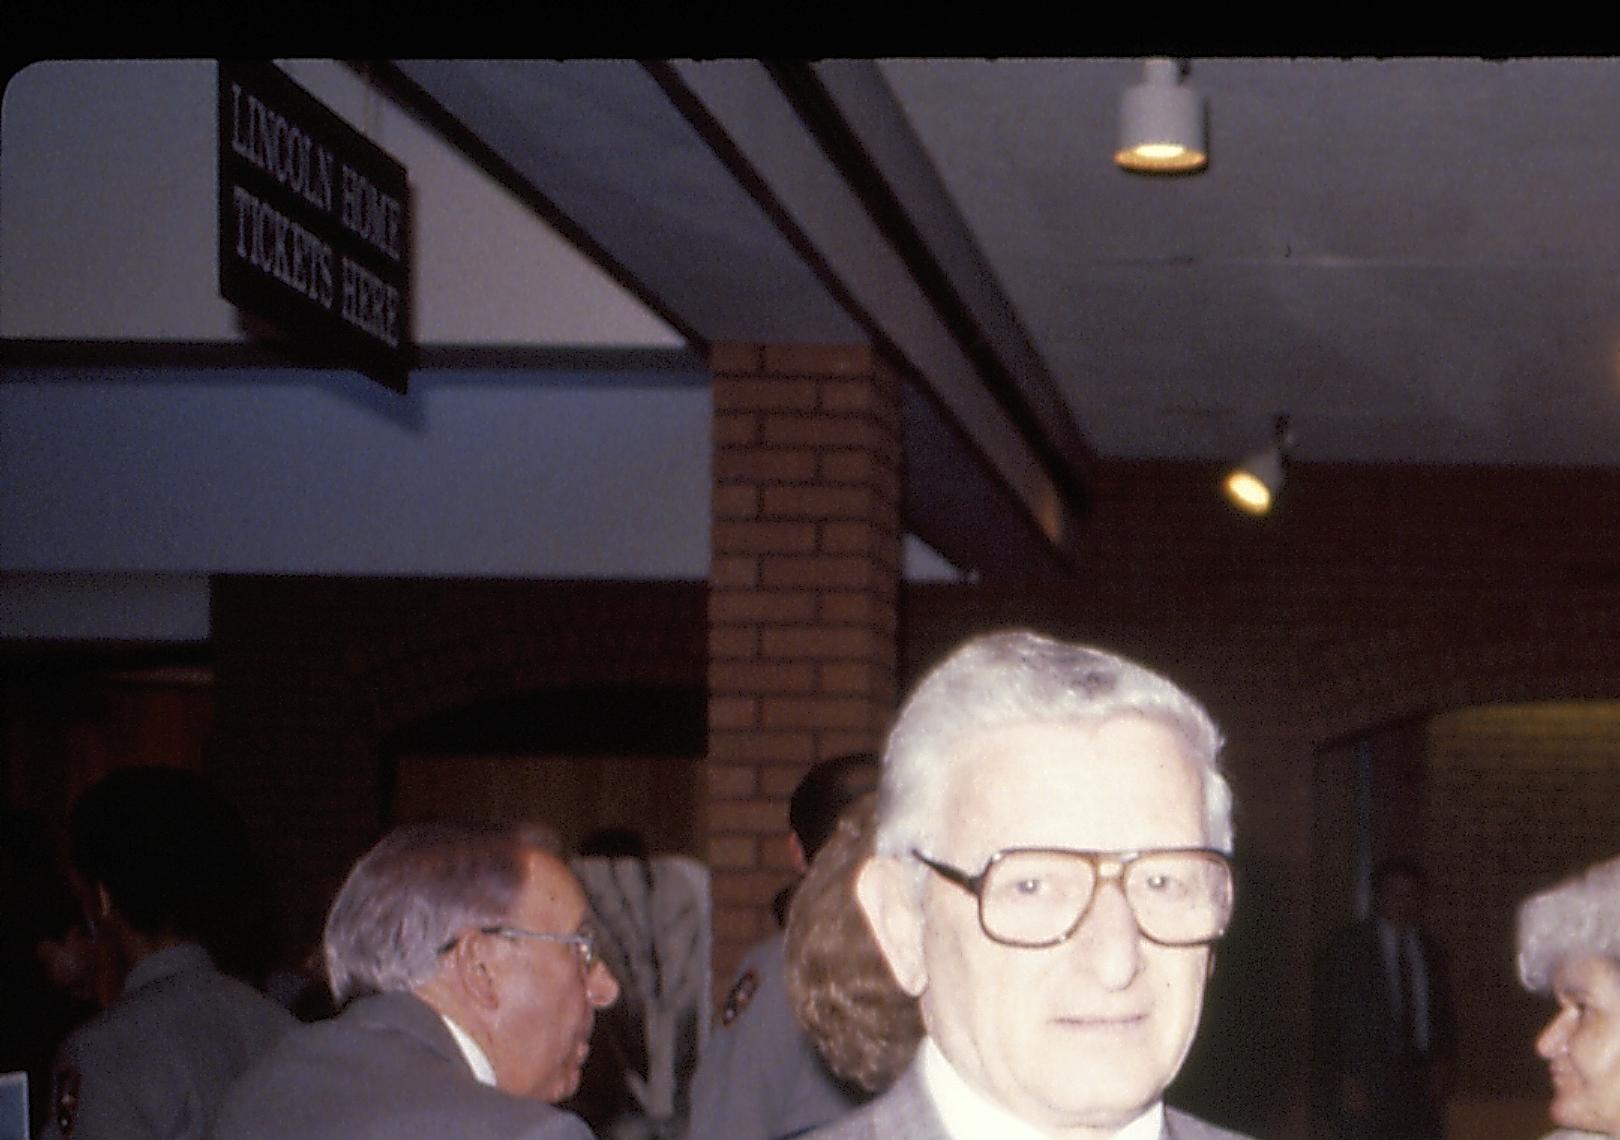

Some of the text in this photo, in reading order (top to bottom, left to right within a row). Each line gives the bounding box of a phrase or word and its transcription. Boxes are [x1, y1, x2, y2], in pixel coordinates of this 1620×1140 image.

[232, 82, 400, 261] LINCOLN HOME
[233, 185, 400, 348] TICKETS HERE
